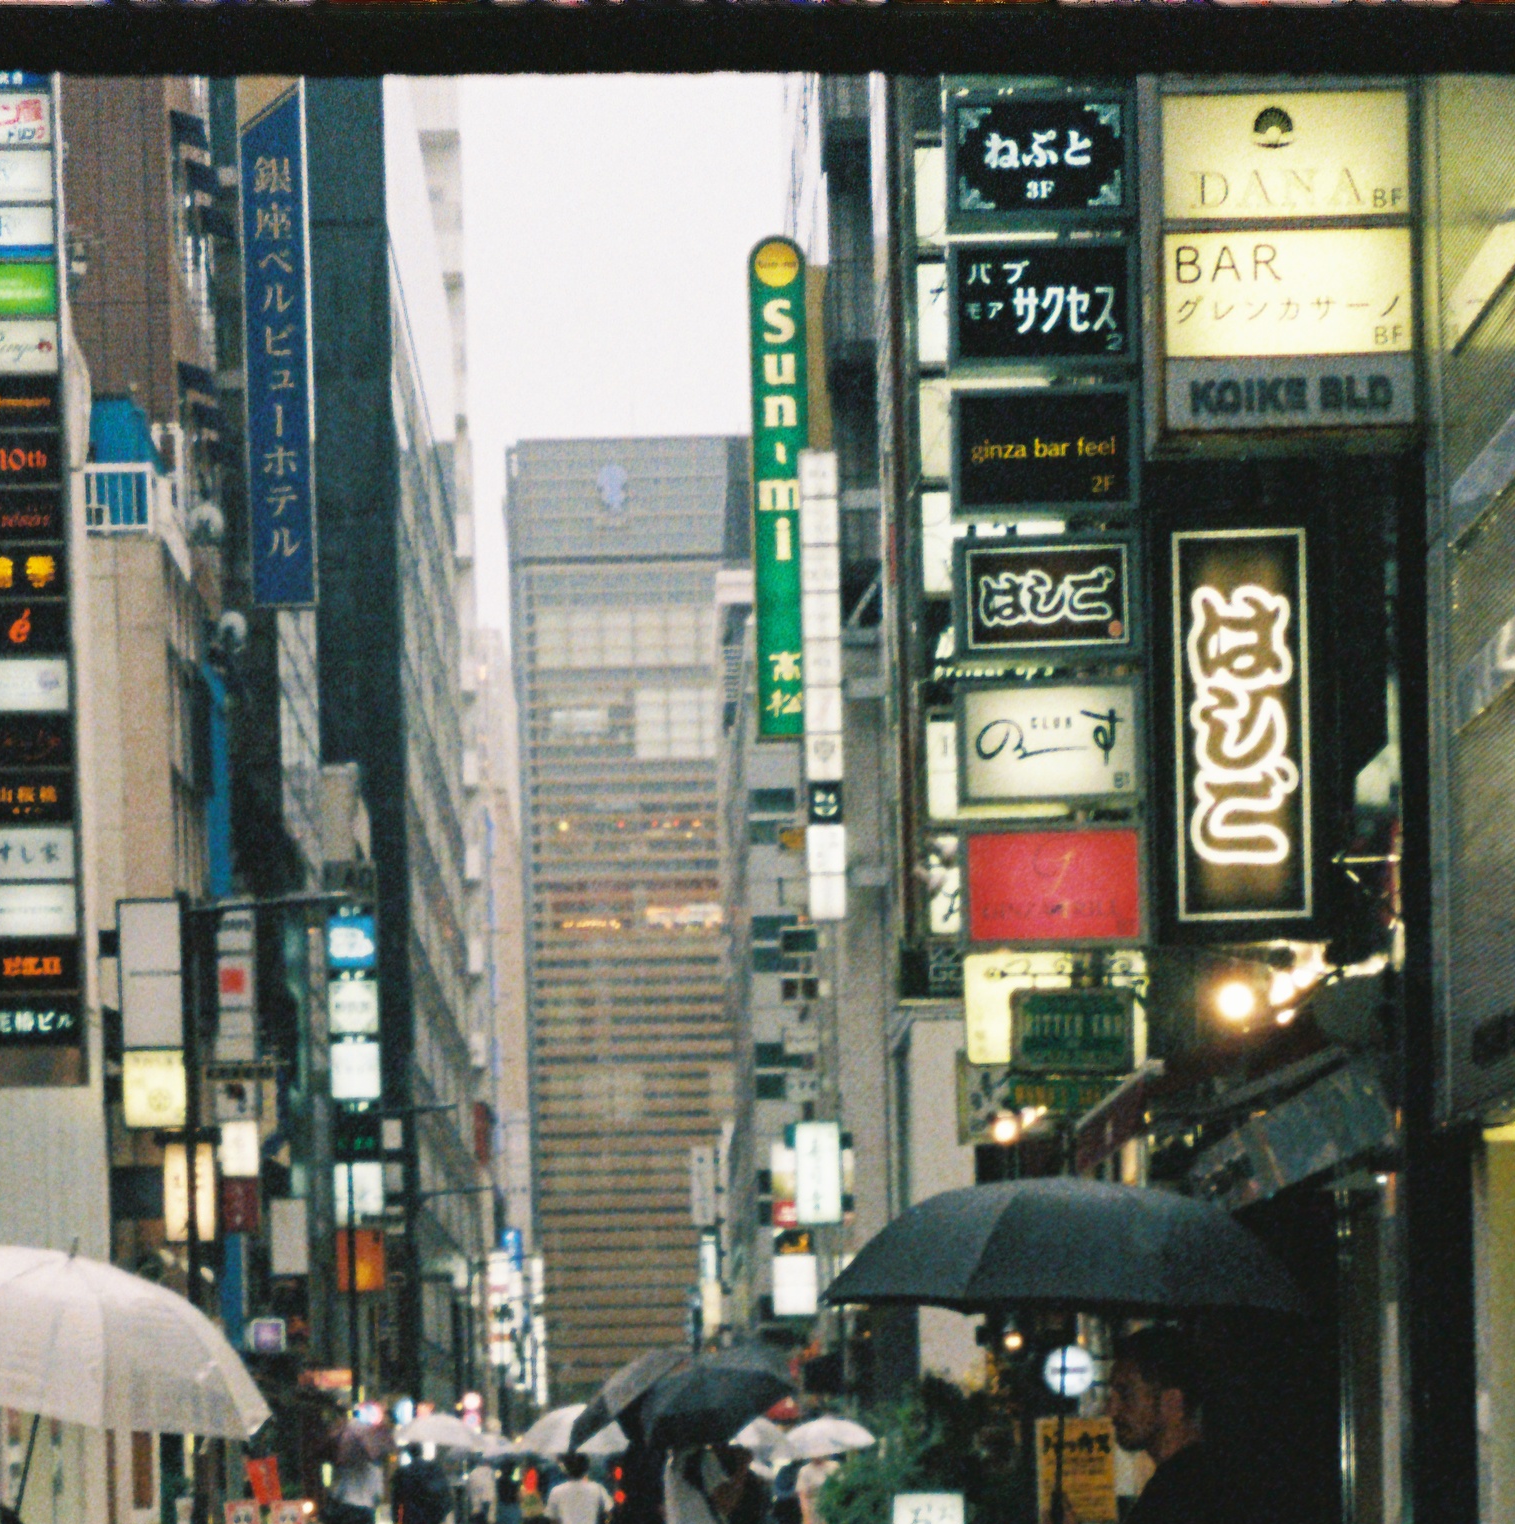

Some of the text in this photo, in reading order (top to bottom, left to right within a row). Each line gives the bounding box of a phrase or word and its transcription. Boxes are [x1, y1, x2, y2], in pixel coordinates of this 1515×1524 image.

[1025, 180, 1055, 199] 3F
[1189, 167, 1363, 209] DANA
[1175, 243, 1282, 284] BAR
[1012, 285, 1118, 335] サクセス
[253, 156, 302, 559] 銀座ベルビューホテル
[1189, 374, 1394, 417] KOIKE BLD
[971, 435, 1116, 464] ginza bar feel
[1030, 716, 1073, 729] CLUB
